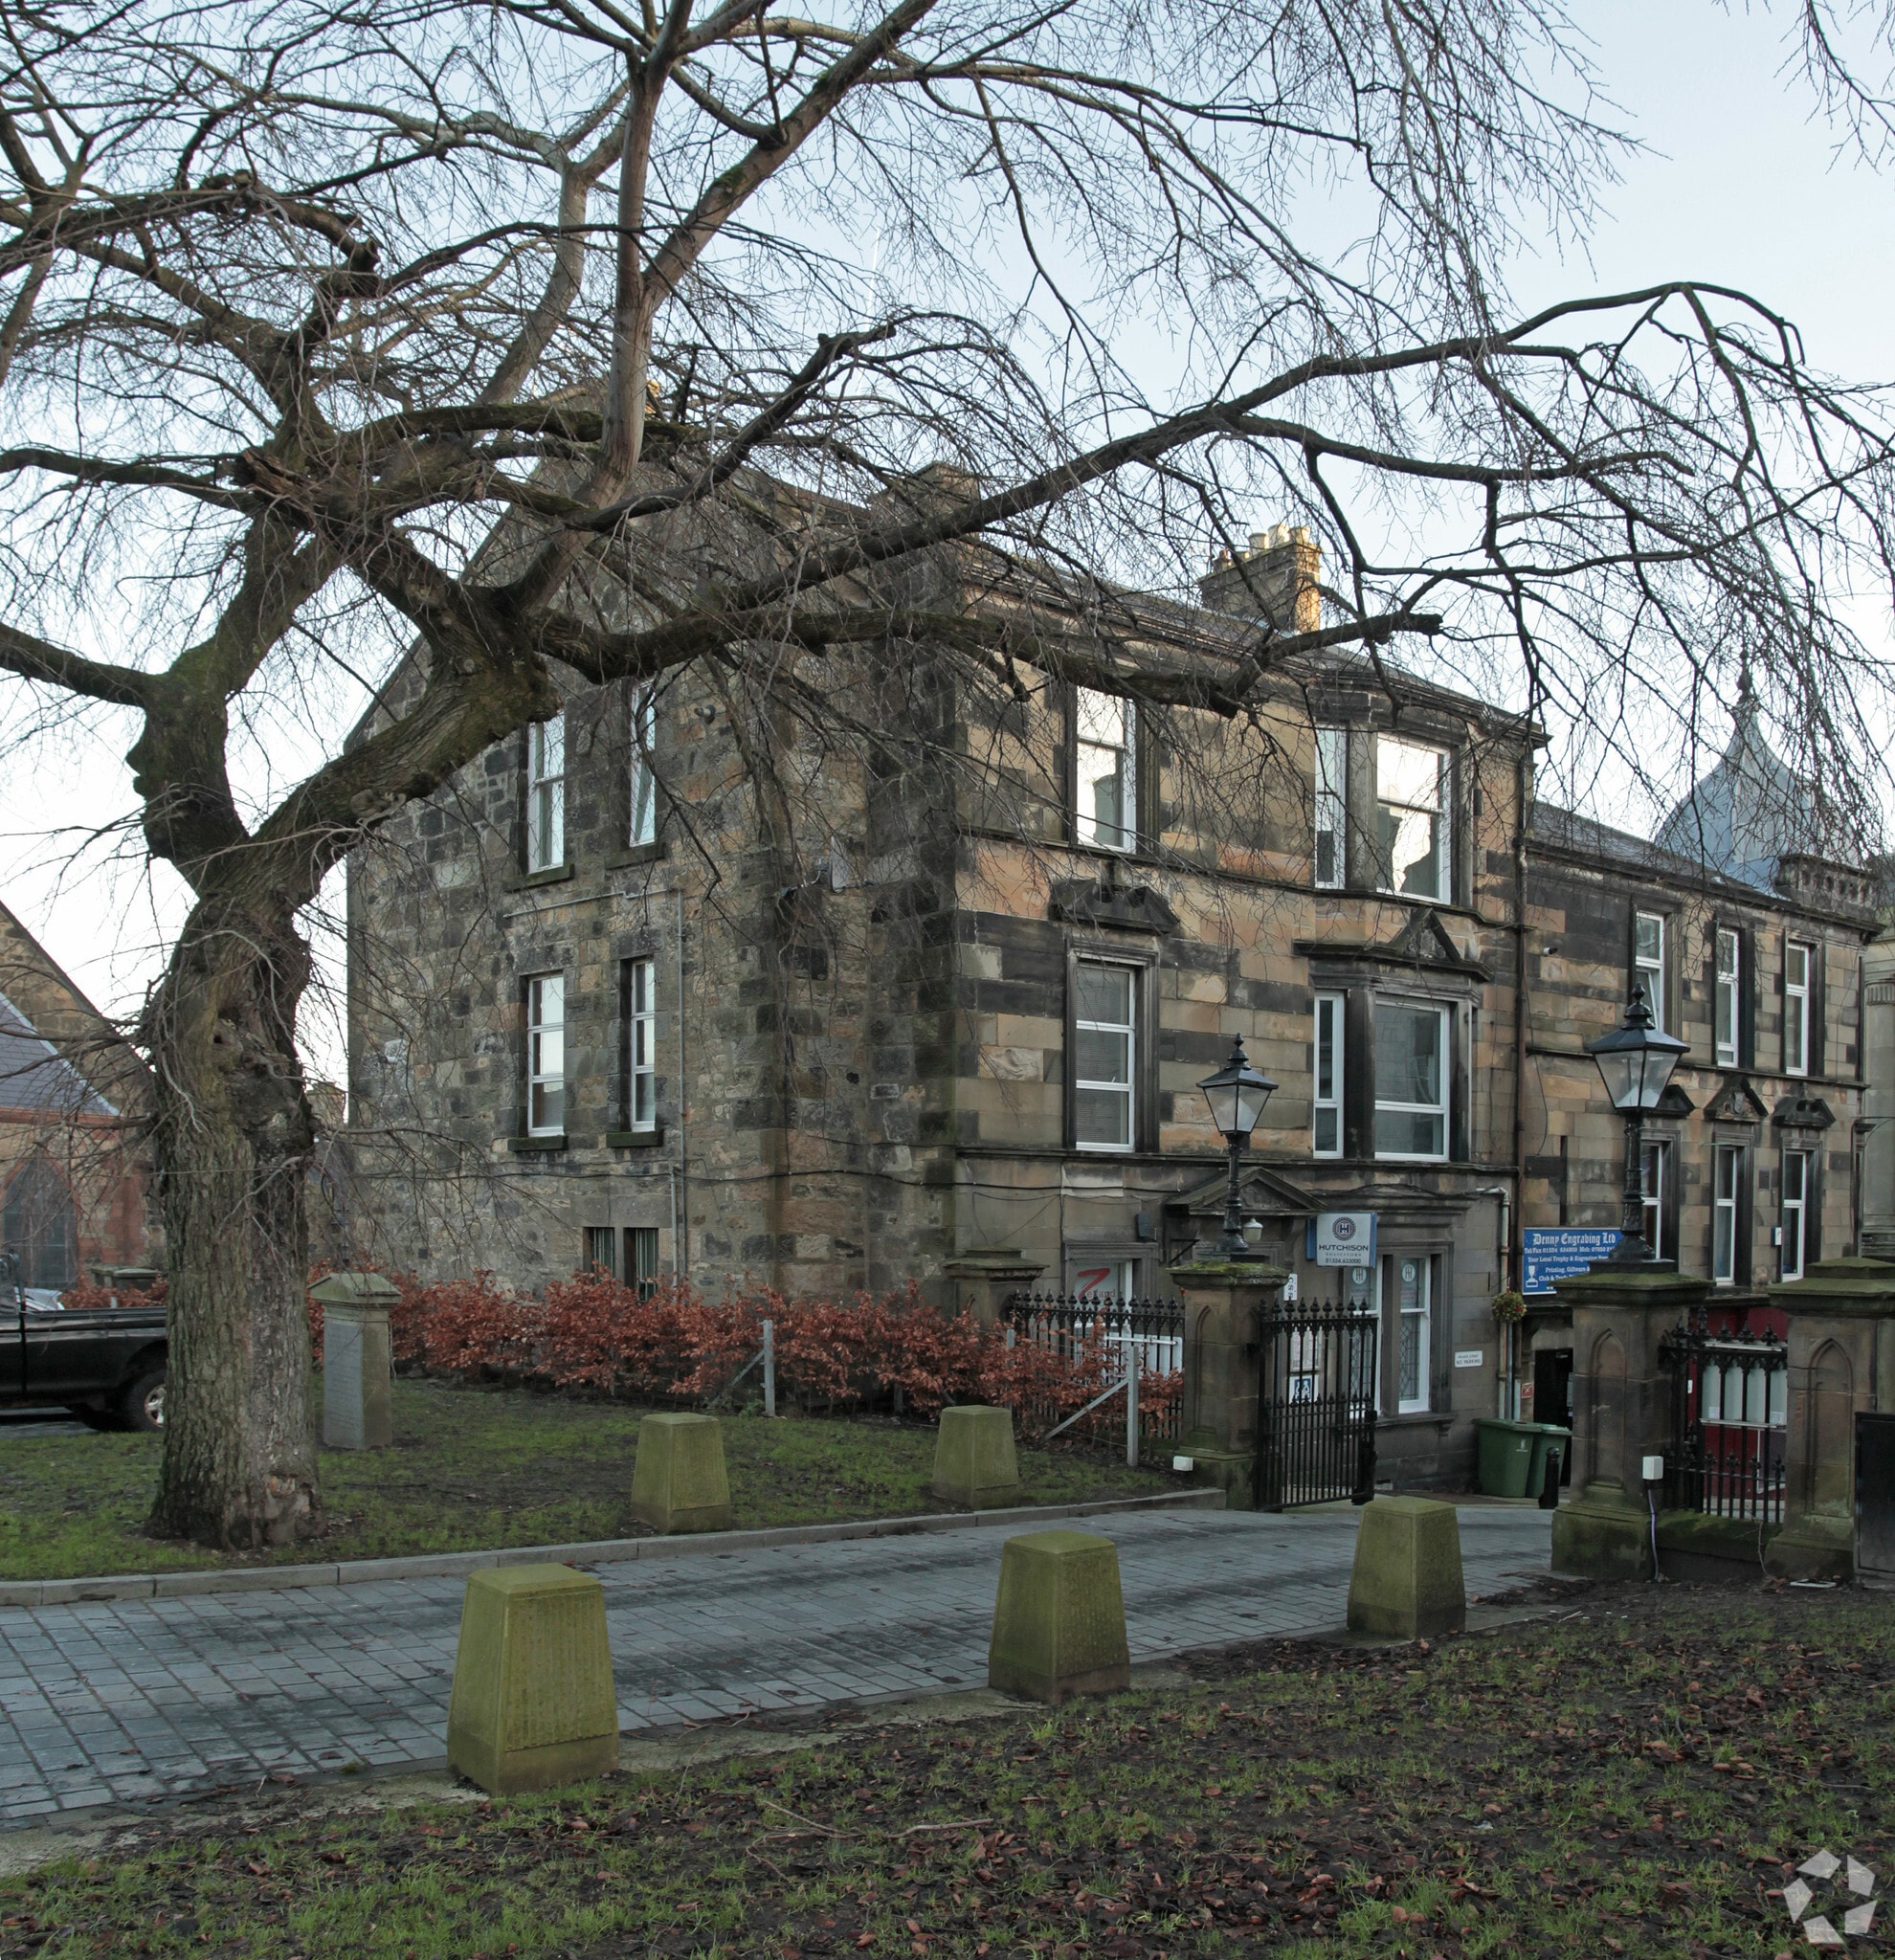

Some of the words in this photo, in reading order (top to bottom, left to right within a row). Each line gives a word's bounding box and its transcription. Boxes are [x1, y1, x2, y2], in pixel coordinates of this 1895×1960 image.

[1533, 1234, 1559, 1246] Denny
[1561, 1233, 1600, 1246] Engraving
[1602, 1233, 1616, 1243] Ltd
